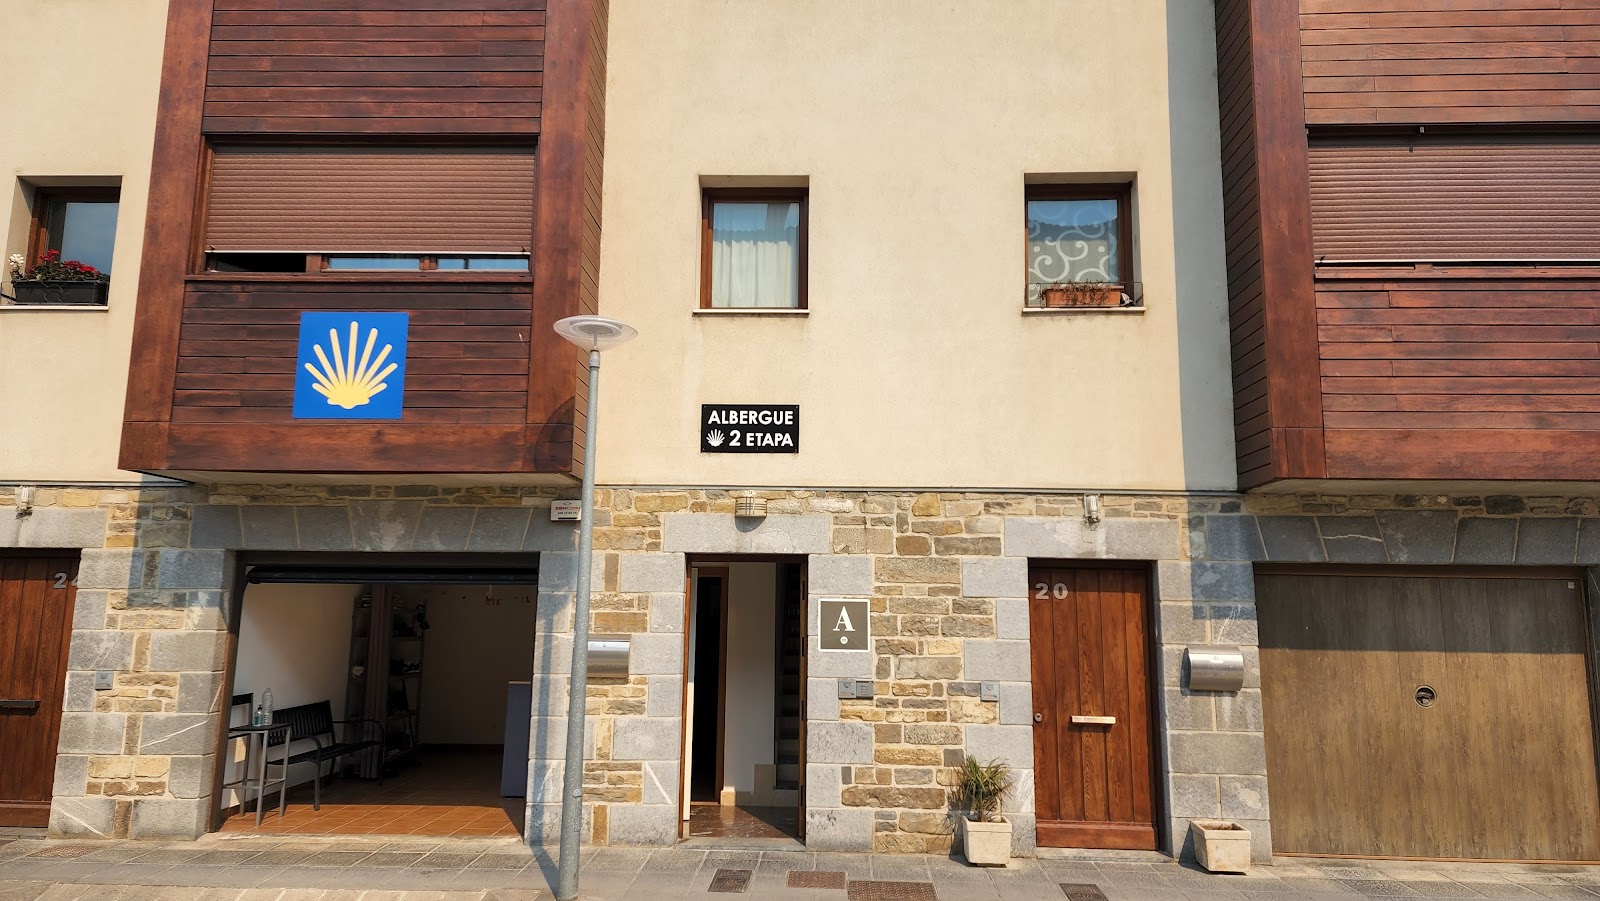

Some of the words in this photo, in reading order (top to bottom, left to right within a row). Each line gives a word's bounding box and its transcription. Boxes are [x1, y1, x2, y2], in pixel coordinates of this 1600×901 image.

[708, 410, 794, 425] ALBERGUE
[729, 429, 741, 447] 2
[746, 432, 794, 447] ETAPA
[1035, 582, 1069, 600] 20
[832, 605, 856, 632] A
